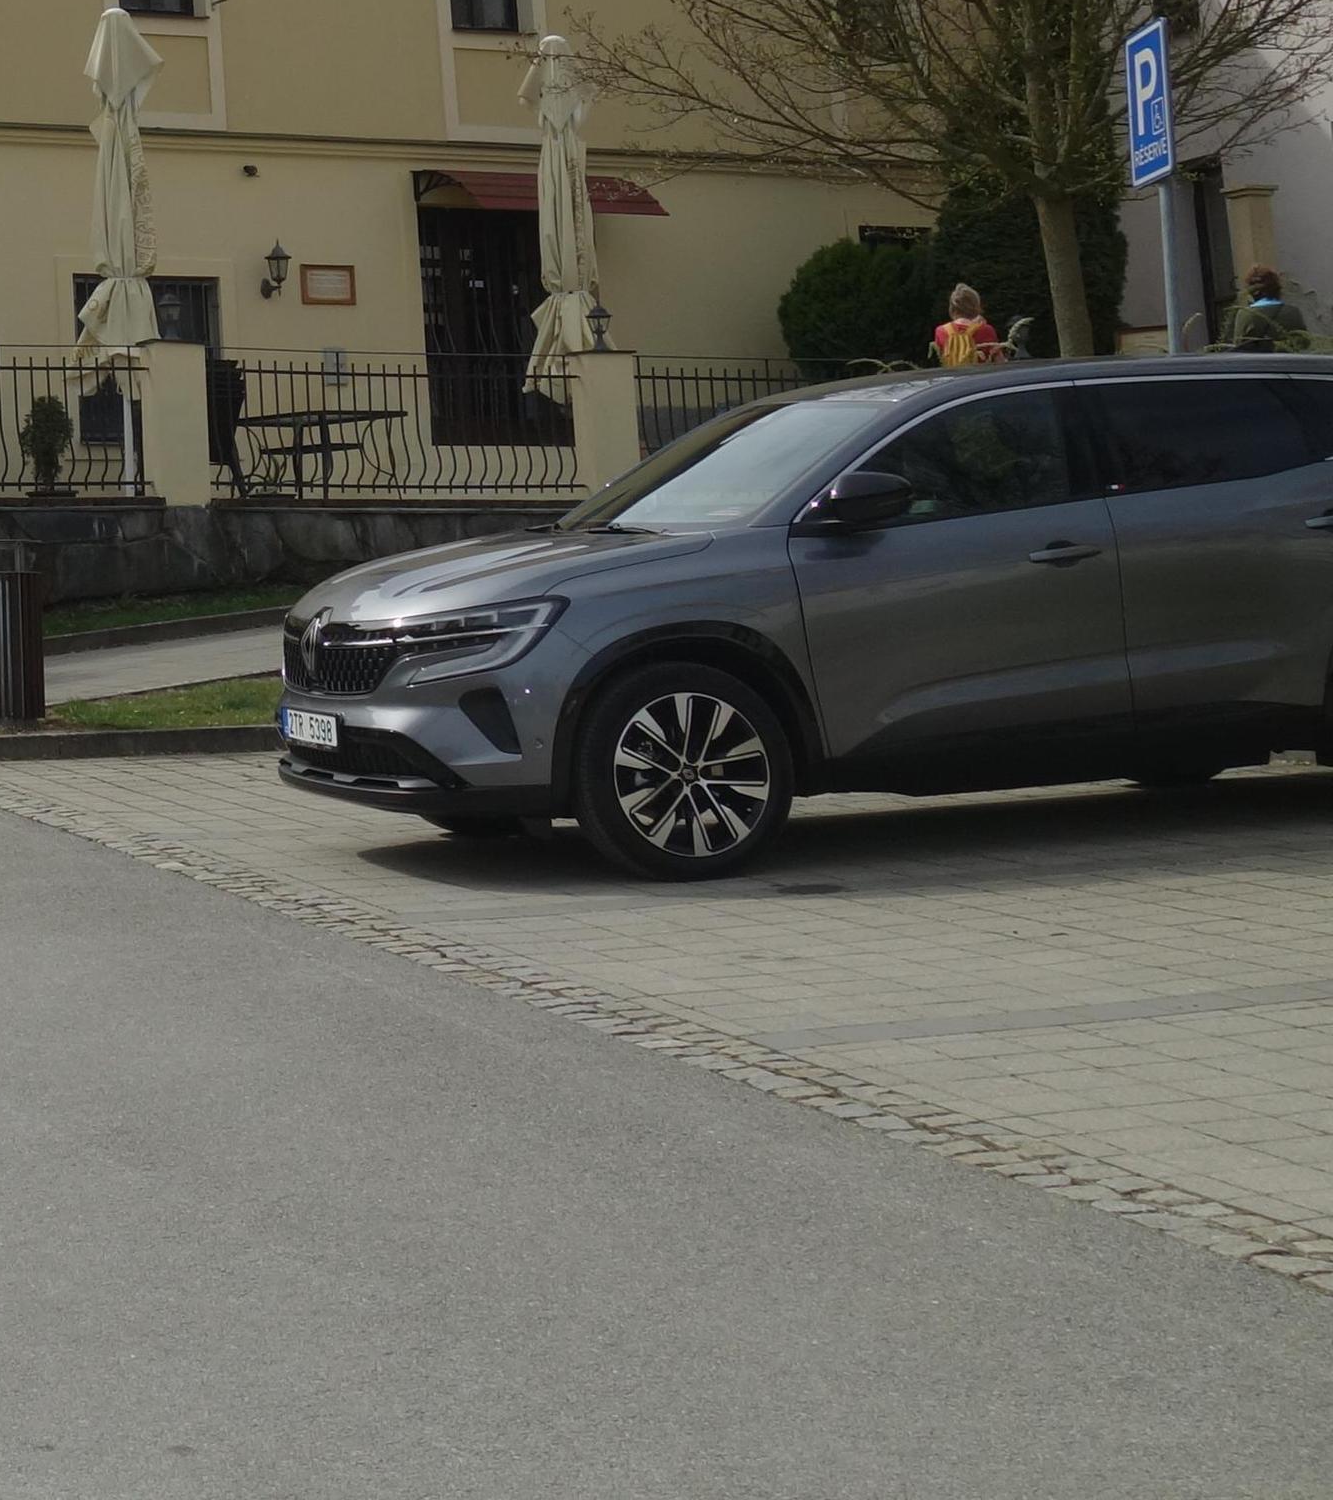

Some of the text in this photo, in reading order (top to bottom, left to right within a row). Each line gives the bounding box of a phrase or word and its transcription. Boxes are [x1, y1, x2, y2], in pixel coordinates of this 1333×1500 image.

[1134, 47, 1157, 136] P
[289, 712, 333, 743] 2TR 5398
